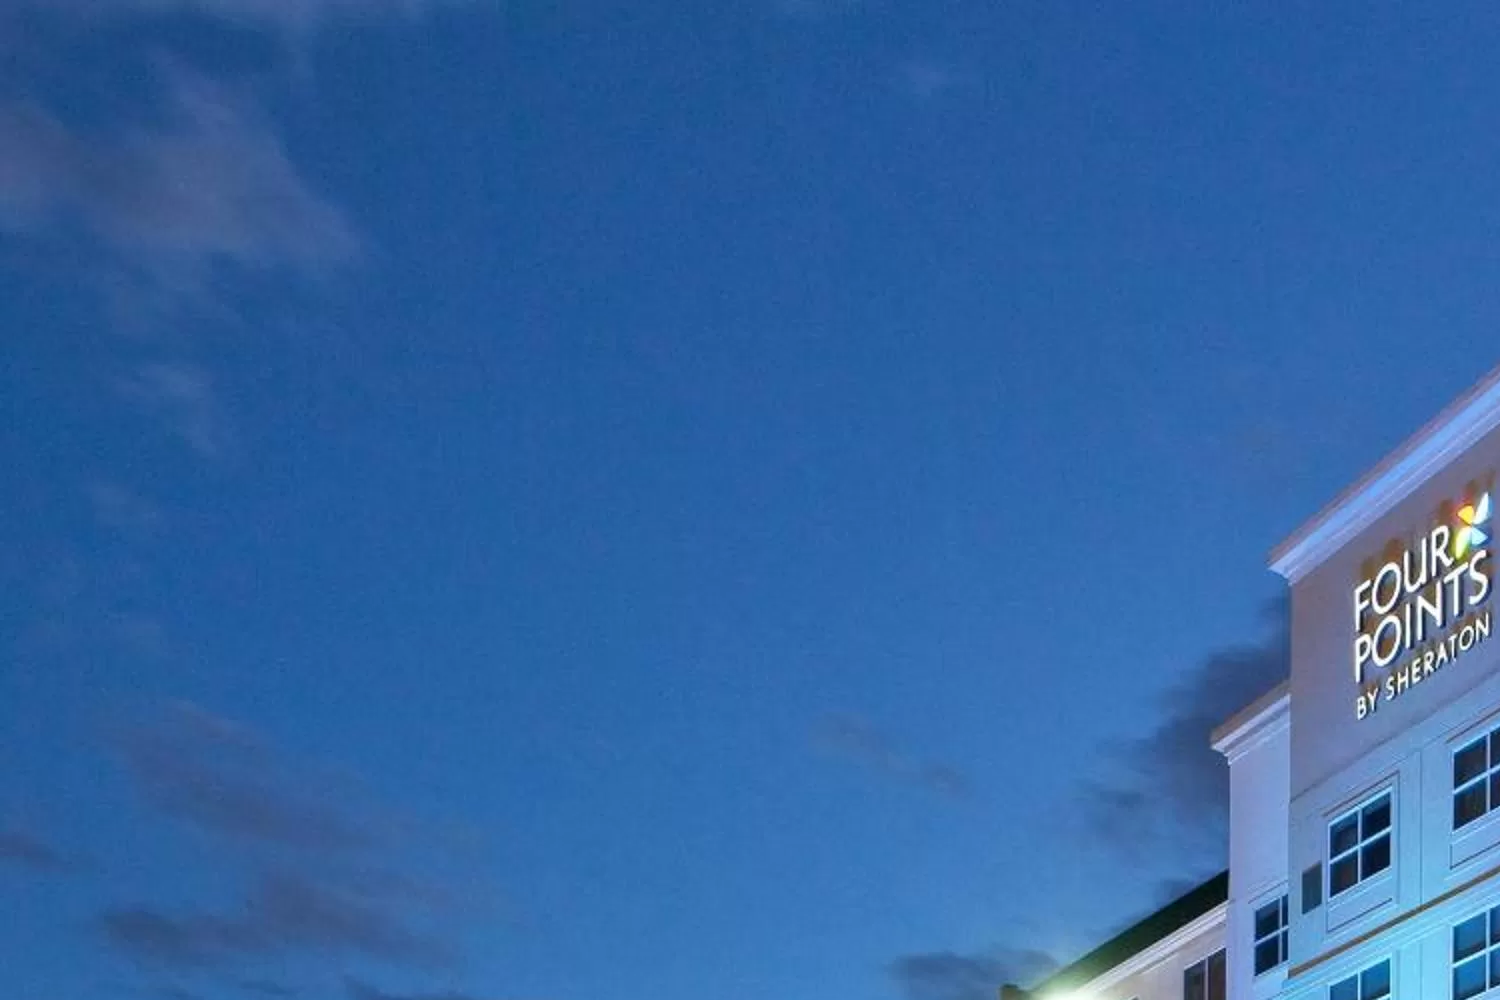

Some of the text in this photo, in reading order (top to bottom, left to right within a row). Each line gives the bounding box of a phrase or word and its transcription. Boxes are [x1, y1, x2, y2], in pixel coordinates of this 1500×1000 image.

[1354, 525, 1454, 632] FOUR
[1354, 550, 1489, 684] POINTS
[1356, 612, 1490, 720] BY SHERATON
